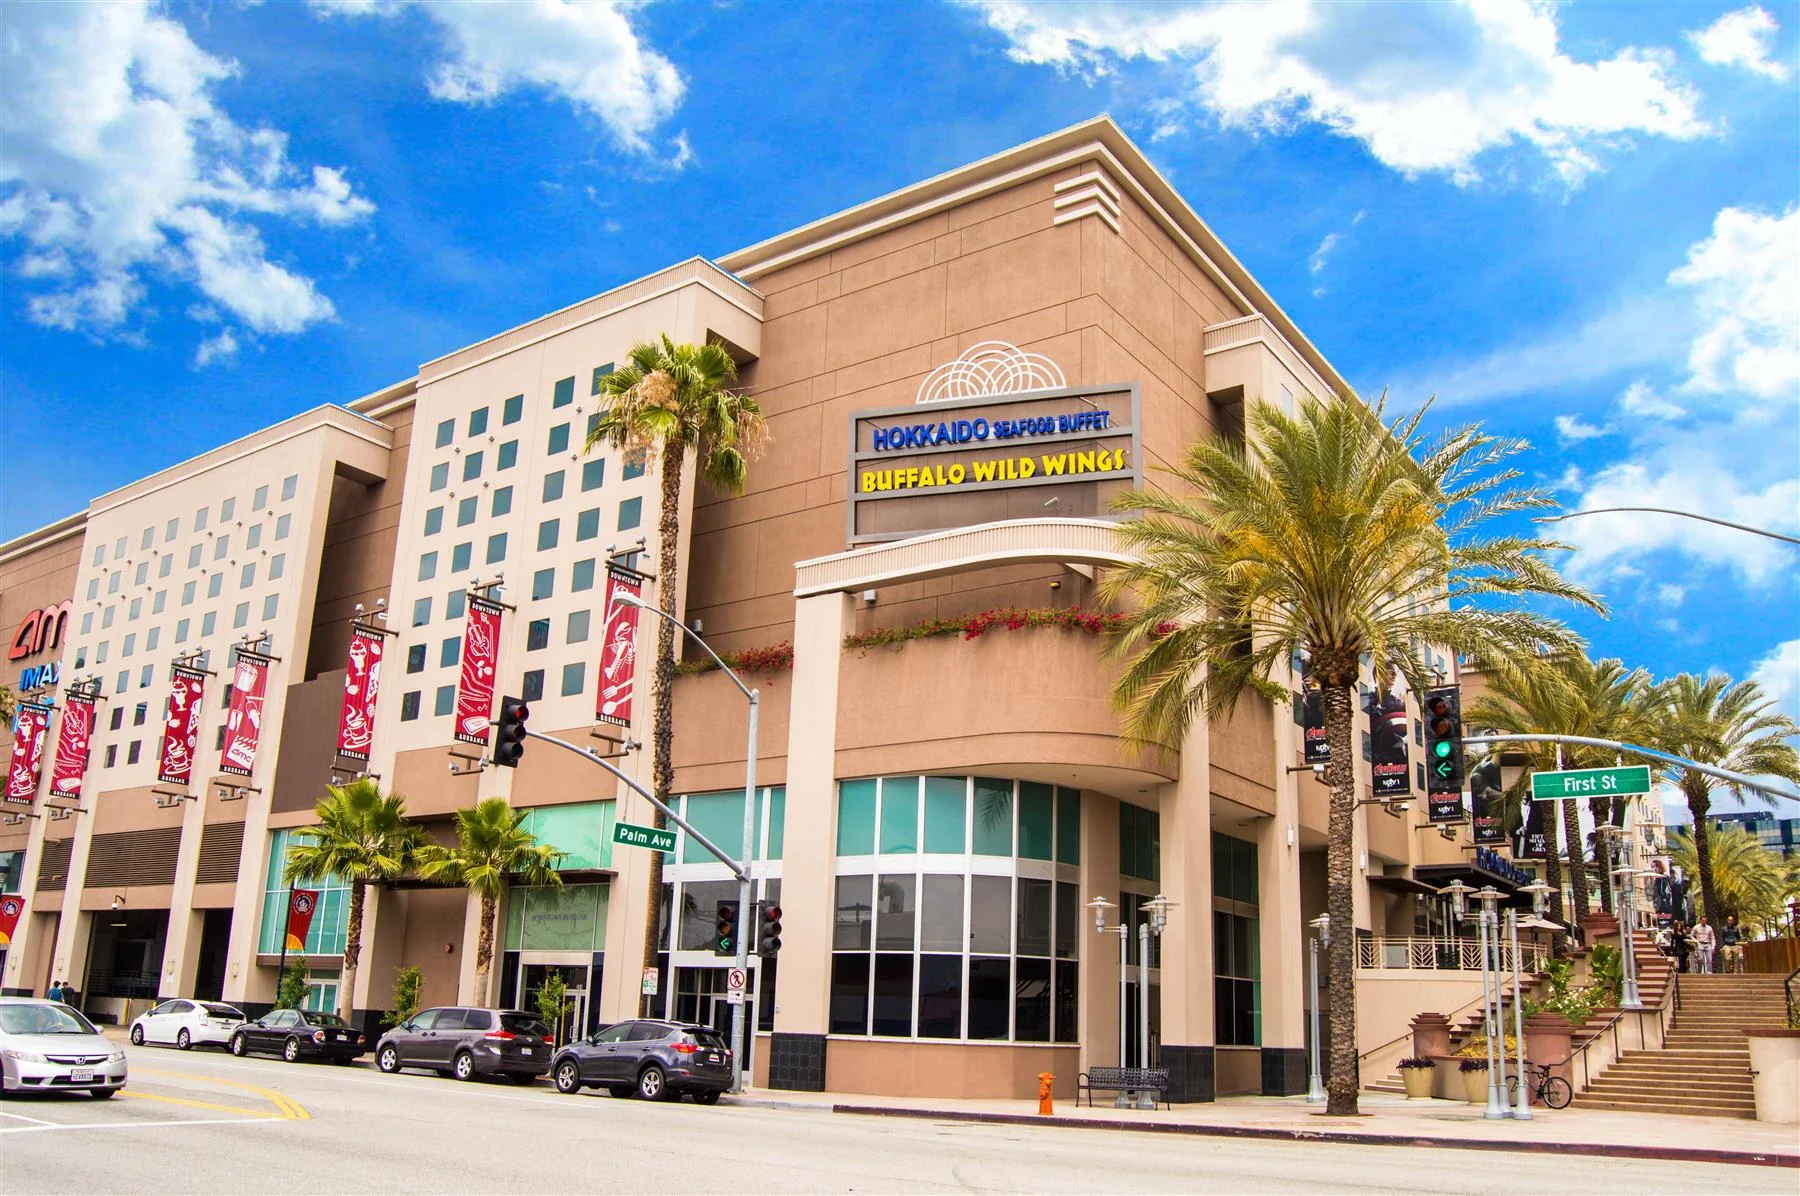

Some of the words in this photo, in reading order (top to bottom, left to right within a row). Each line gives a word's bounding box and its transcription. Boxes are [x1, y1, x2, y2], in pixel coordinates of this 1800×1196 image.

[873, 417, 989, 451] HOKKAIDO
[993, 416, 1055, 438] SEAFOOD
[1058, 410, 1109, 433] BUFFET
[862, 463, 966, 493] BUFFALO
[972, 457, 1036, 481] WILD
[1041, 448, 1125, 476] WINGS
[610, 571, 639, 586] DOWNTOWN
[472, 602, 499, 616] DOWNTOWN
[600, 714, 625, 726] BURBANK
[459, 733, 484, 744] BURBANK
[340, 749, 366, 760] BURBANK
[1564, 776, 1596, 792] First
[1601, 774, 1617, 790] St
[619, 828, 648, 843] Palm
[651, 834, 672, 847] Ave
